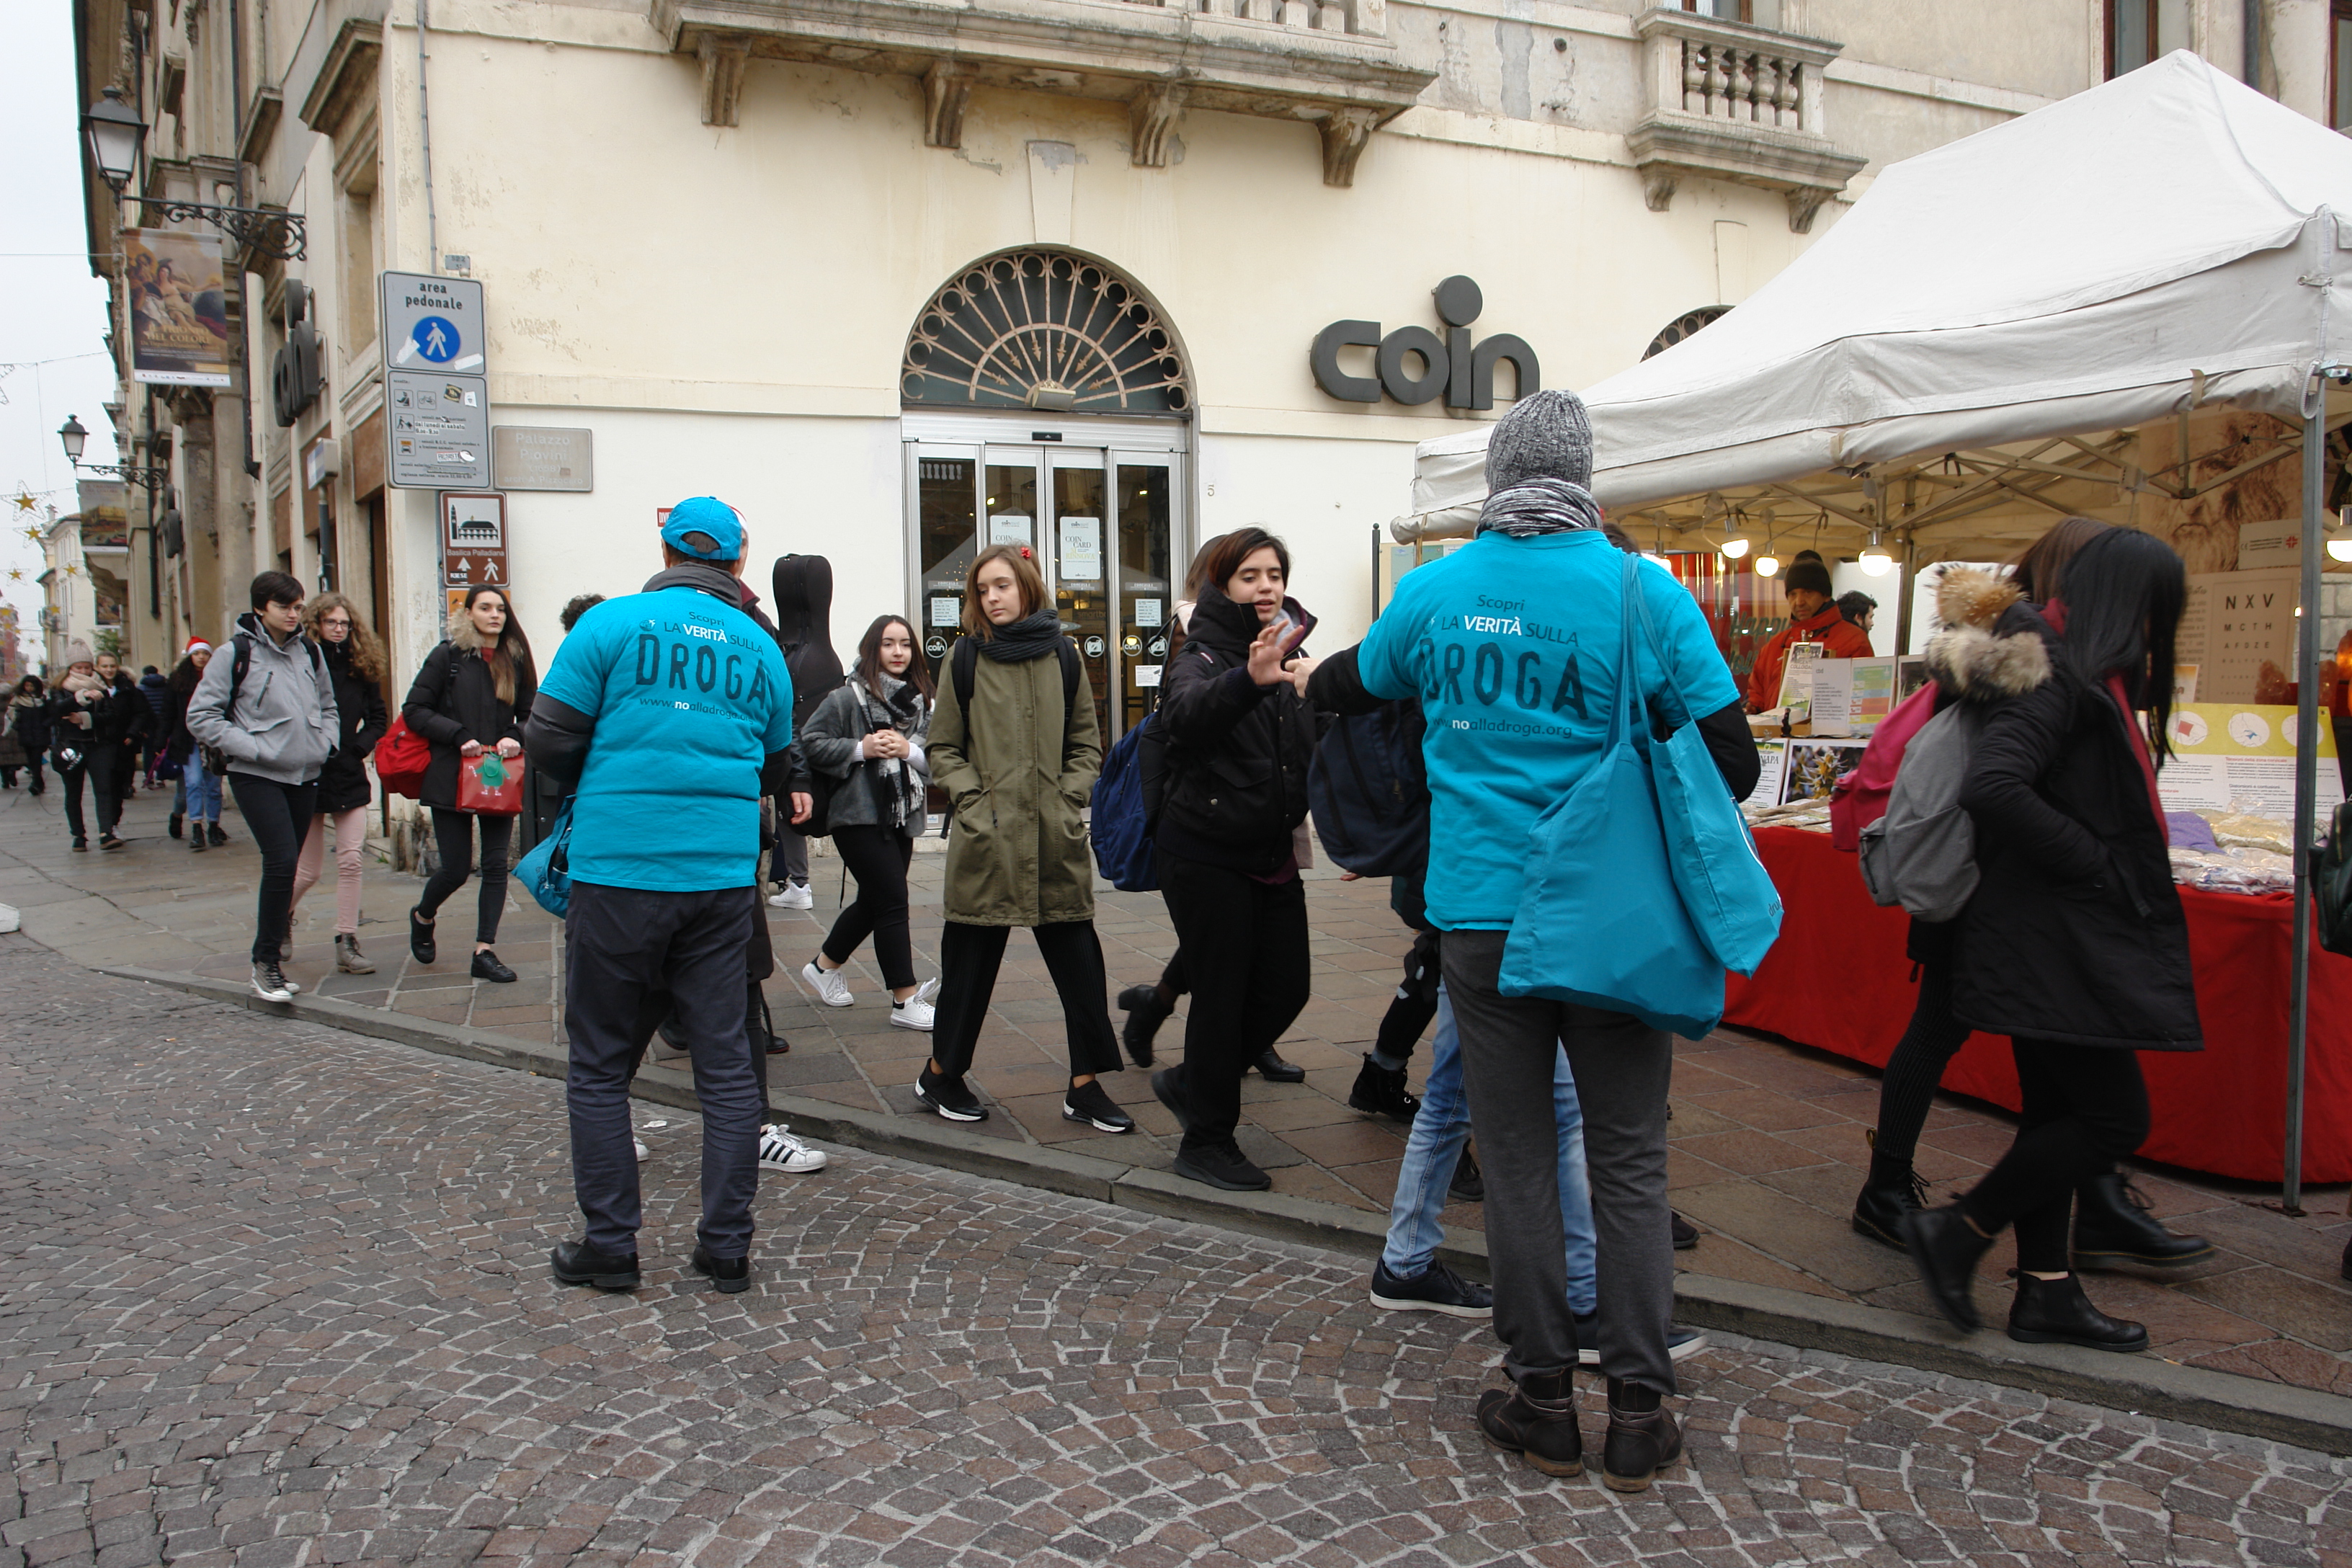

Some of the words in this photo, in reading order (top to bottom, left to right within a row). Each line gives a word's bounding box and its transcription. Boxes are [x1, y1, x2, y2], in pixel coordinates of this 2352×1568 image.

[419, 282, 447, 293] area
[405, 294, 463, 310] pedonale
[1309, 275, 1540, 410] coin
[515, 433, 570, 445] Palazzo
[520, 449, 567, 460] Piovini
[1208, 484, 1215, 496] 5
[1476, 594, 1525, 612] Scopri
[2225, 595, 2236, 610] N
[2245, 594, 2255, 609] X
[2263, 593, 2273, 608] V
[688, 611, 725, 627] Scopri
[664, 621, 682, 634] LA
[682, 623, 729, 643] VERITÀ
[729, 634, 764, 656] SULLA
[1441, 615, 1459, 631] LA
[1464, 615, 1522, 636] VERITÀ
[1525, 623, 1579, 647] SULLA
[927, 641, 945, 651] coin
[636, 633, 768, 710] DROGA
[1418, 637, 1589, 720] DROGA
[639, 697, 754, 725] www.noalladroga.org
